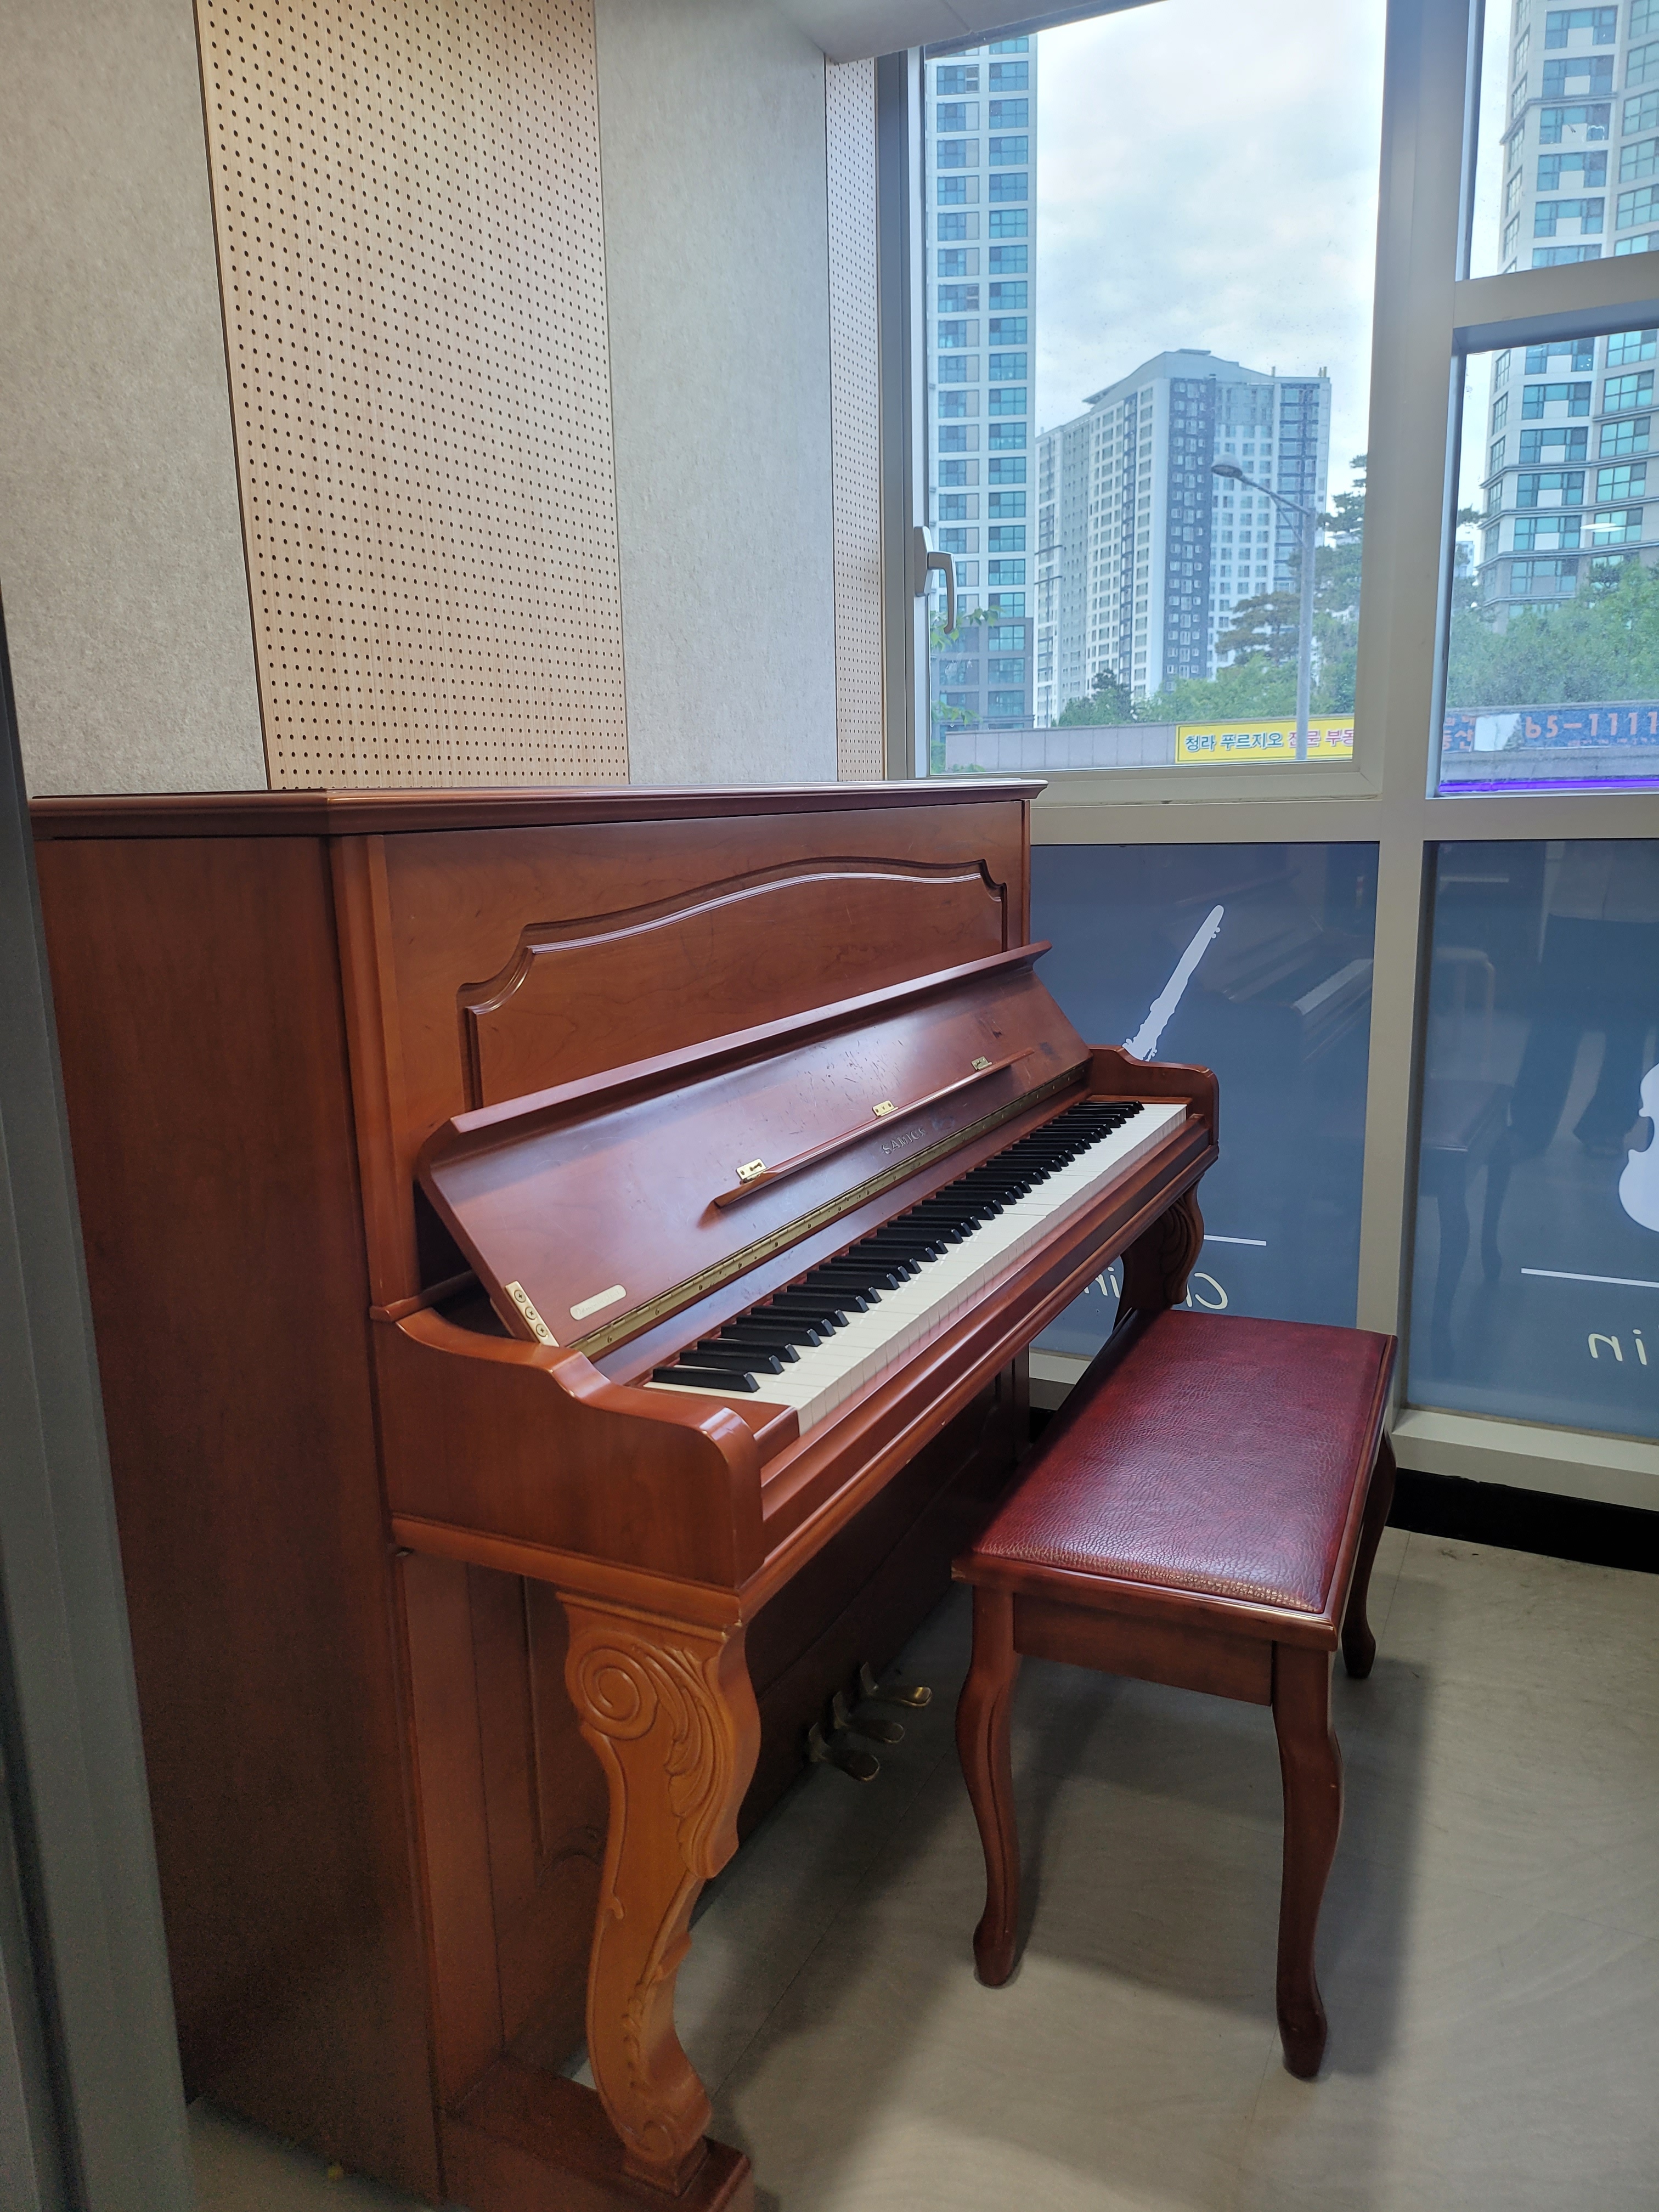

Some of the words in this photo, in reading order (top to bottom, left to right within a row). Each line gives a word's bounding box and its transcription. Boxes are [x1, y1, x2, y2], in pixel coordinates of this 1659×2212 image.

[1186, 735, 1215, 751] 청라
[1221, 732, 1283, 749] 푸르지오
[881, 1126, 926, 1155] SAMICK
